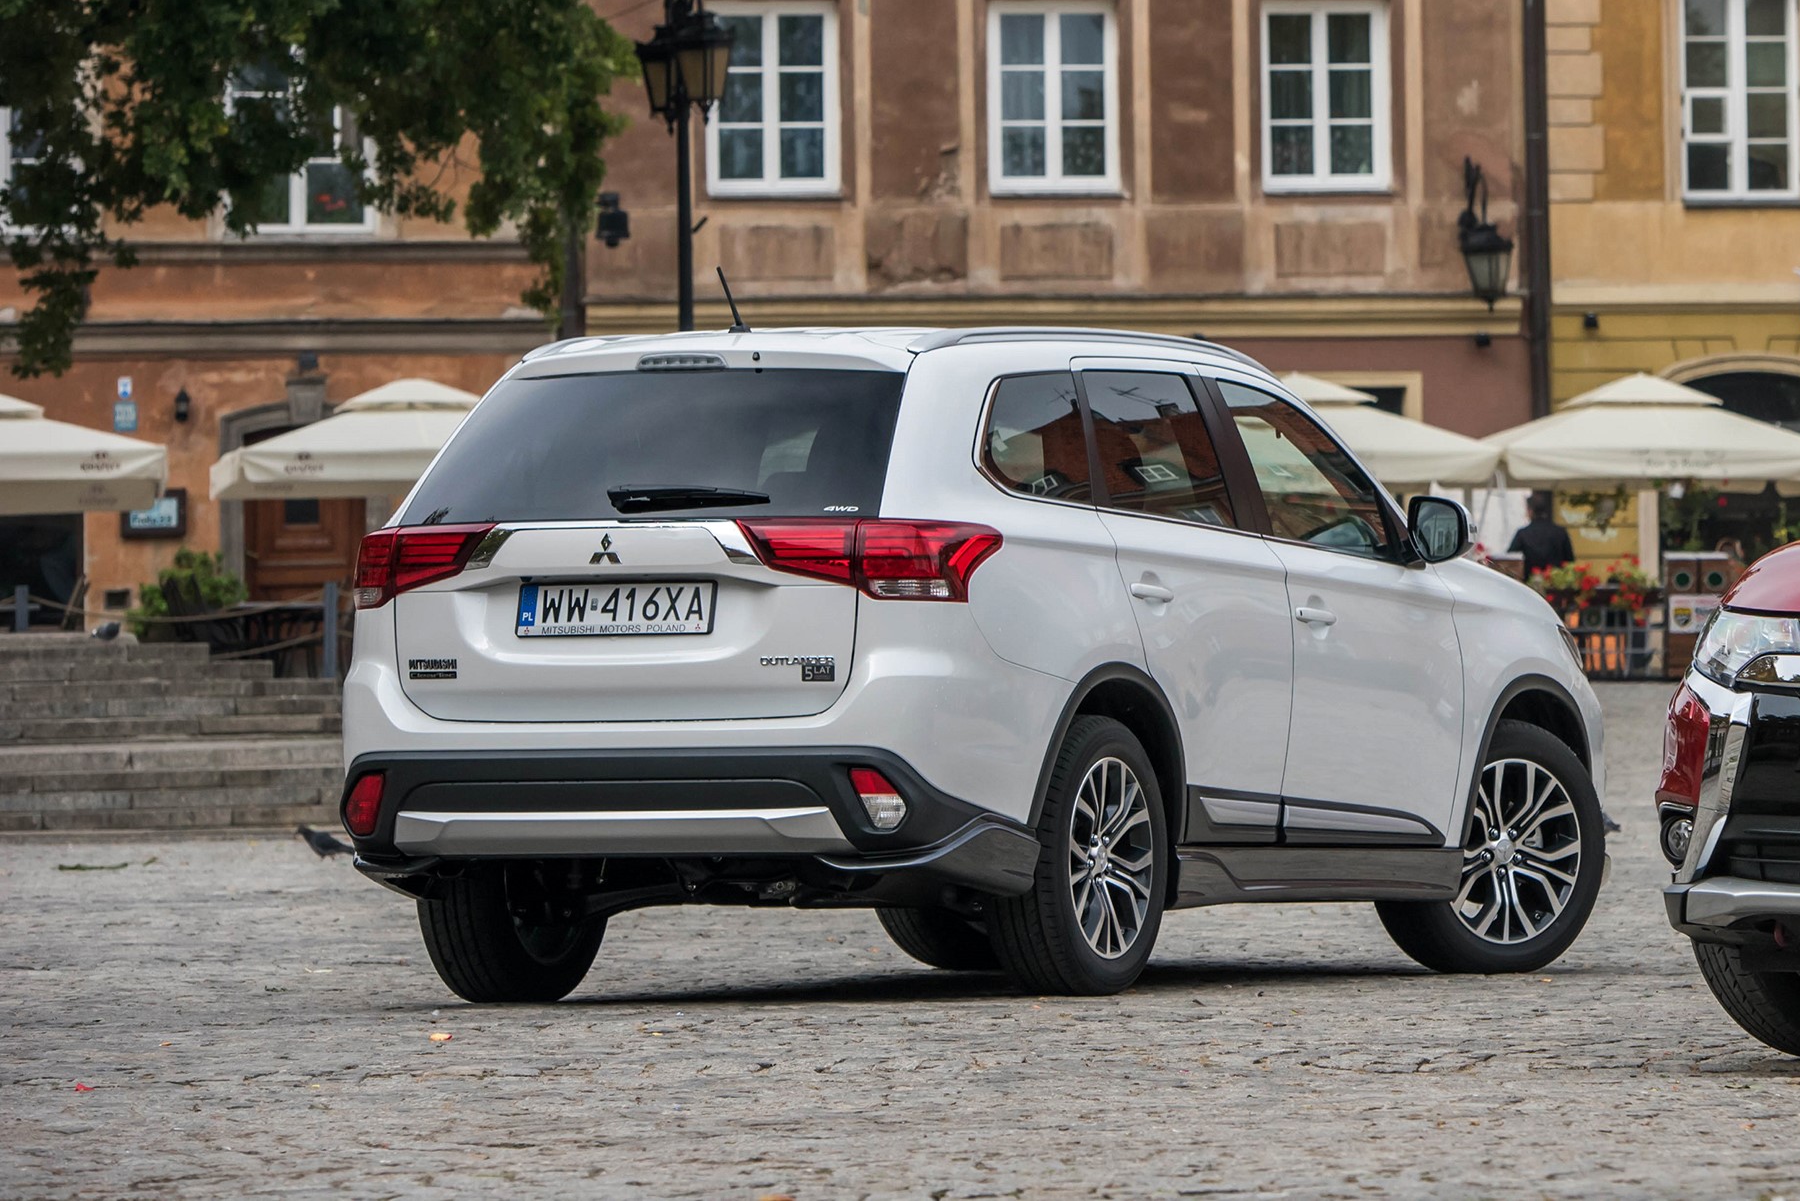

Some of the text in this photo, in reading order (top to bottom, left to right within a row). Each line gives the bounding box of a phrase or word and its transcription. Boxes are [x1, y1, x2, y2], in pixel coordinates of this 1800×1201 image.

[542, 587, 704, 623] WW 416XA
[522, 612, 534, 622] PL
[541, 623, 686, 635] MITSUBISHI MOTORS POLAND
[409, 659, 457, 670] MITSUBISHI
[760, 655, 835, 666] OUTLANDER
[804, 666, 831, 680] 5 LAT
